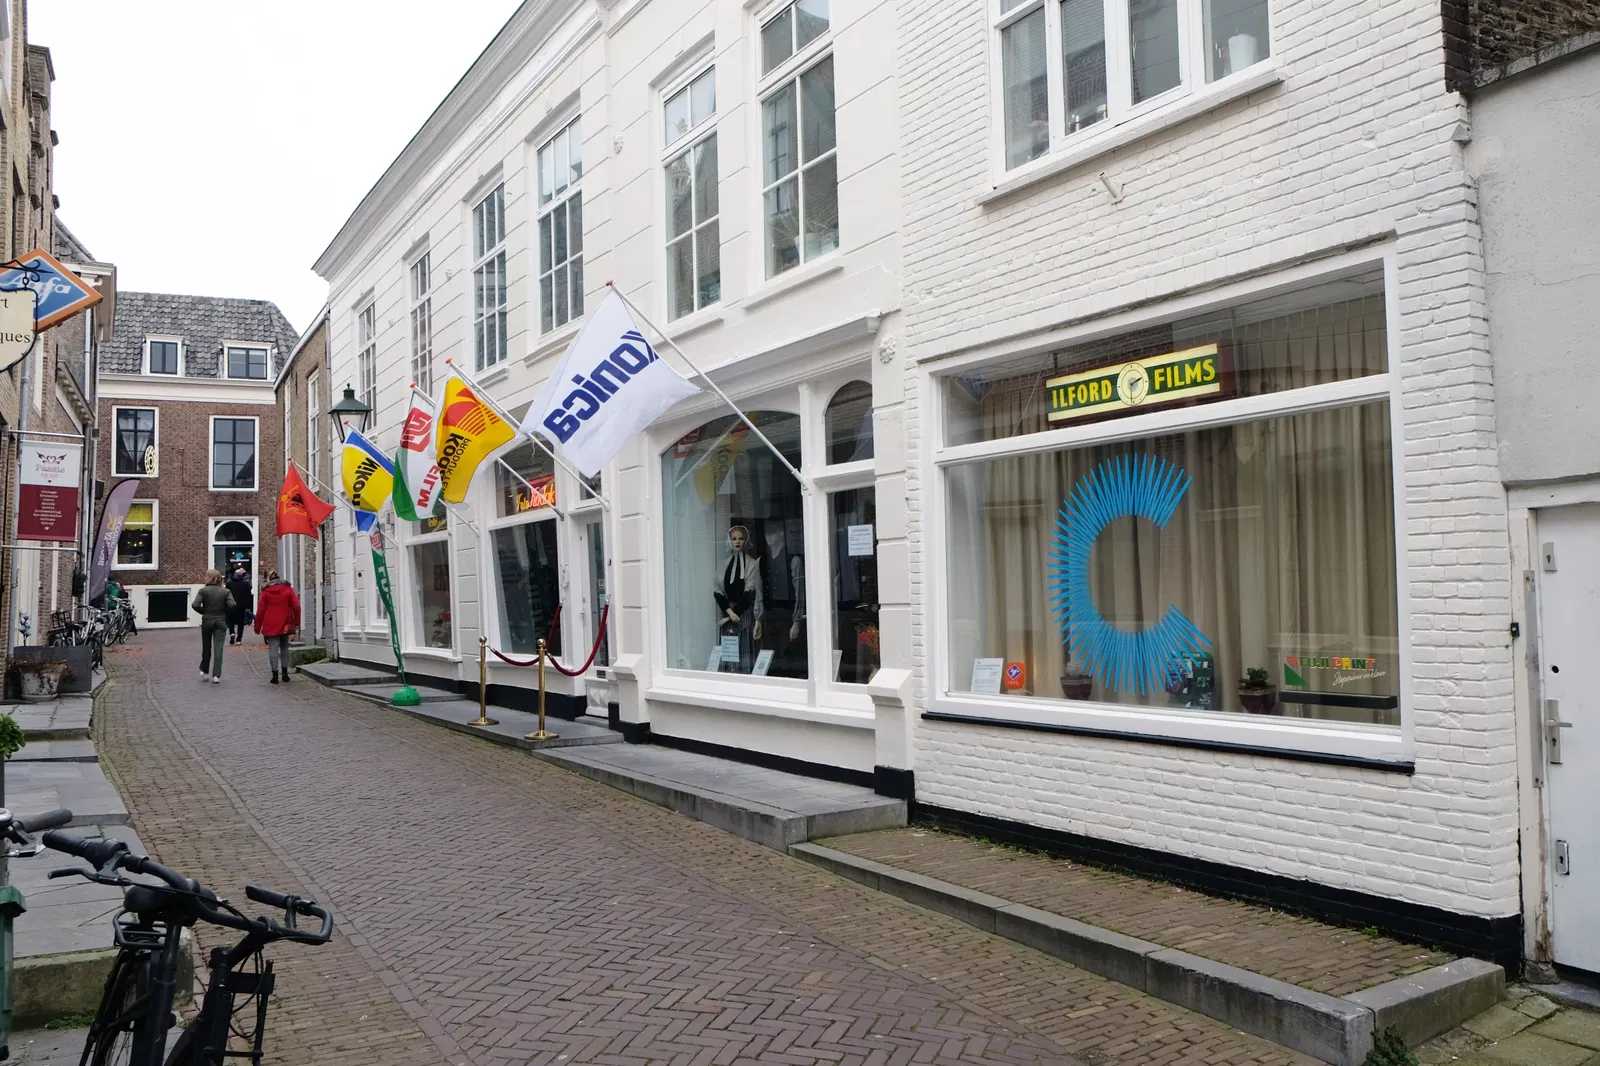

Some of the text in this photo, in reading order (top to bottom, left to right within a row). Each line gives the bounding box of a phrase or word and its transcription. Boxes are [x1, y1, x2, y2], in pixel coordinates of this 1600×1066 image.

[1051, 358, 1216, 409] ILFORD FILMS
[1299, 656, 1377, 671] FUJI PRINT
